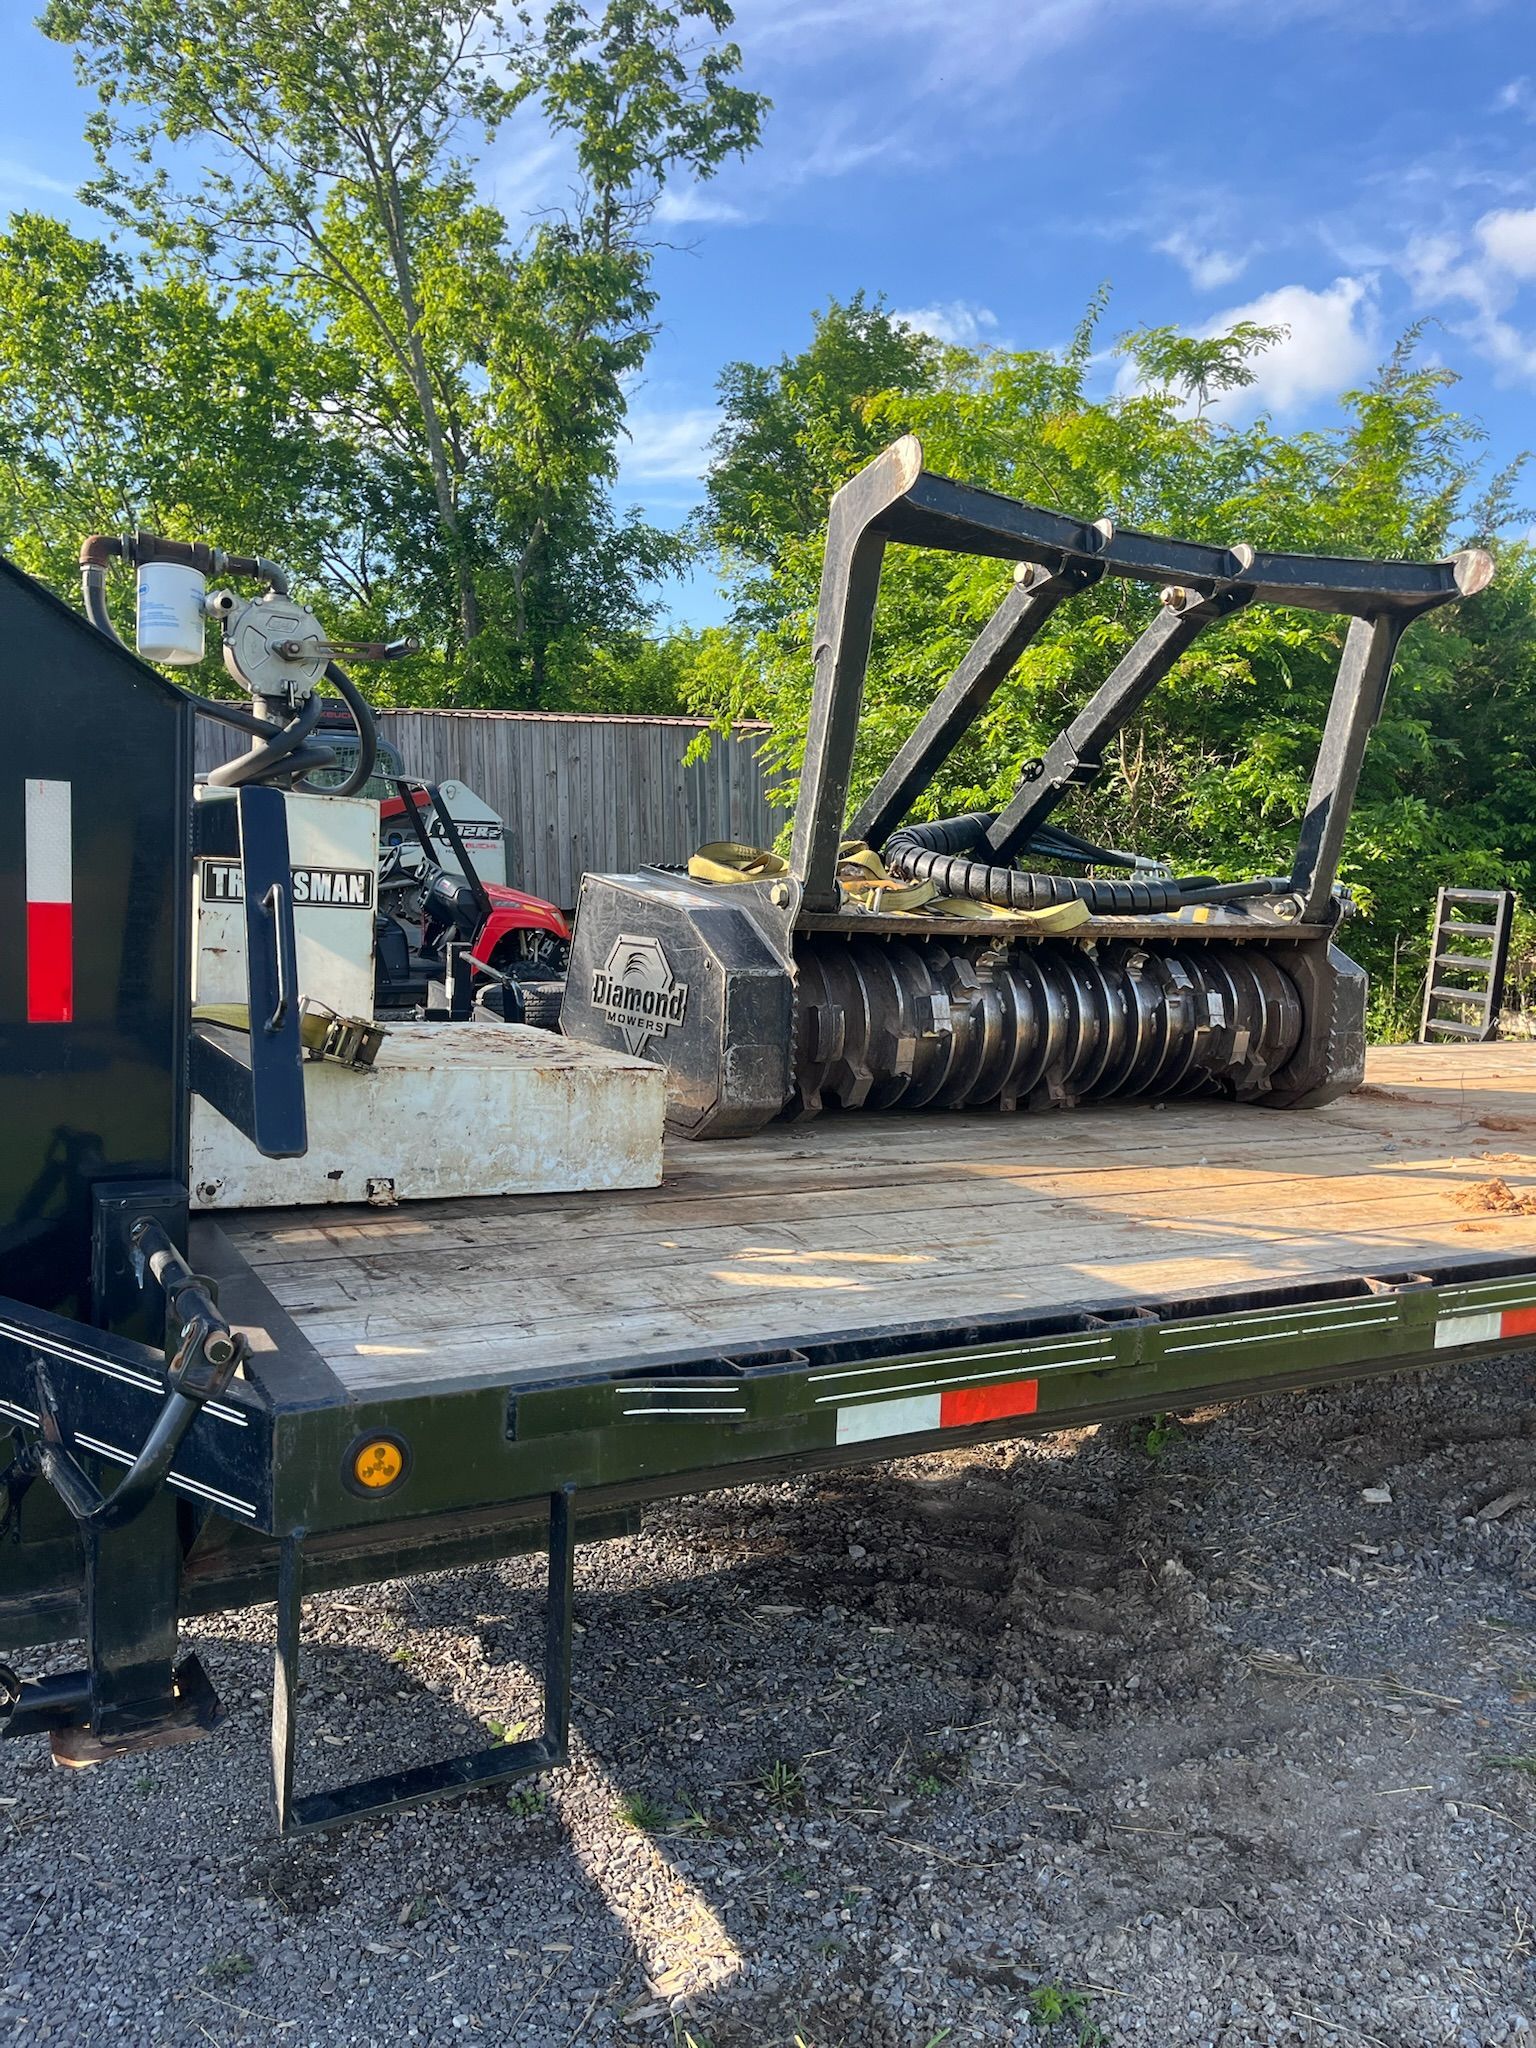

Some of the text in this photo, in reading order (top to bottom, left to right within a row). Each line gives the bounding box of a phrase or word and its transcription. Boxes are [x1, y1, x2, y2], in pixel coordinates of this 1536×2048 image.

[212, 867, 365, 903] TRSMAN
[593, 973, 685, 1021] Diamond
[607, 1011, 664, 1032] MOWERS
